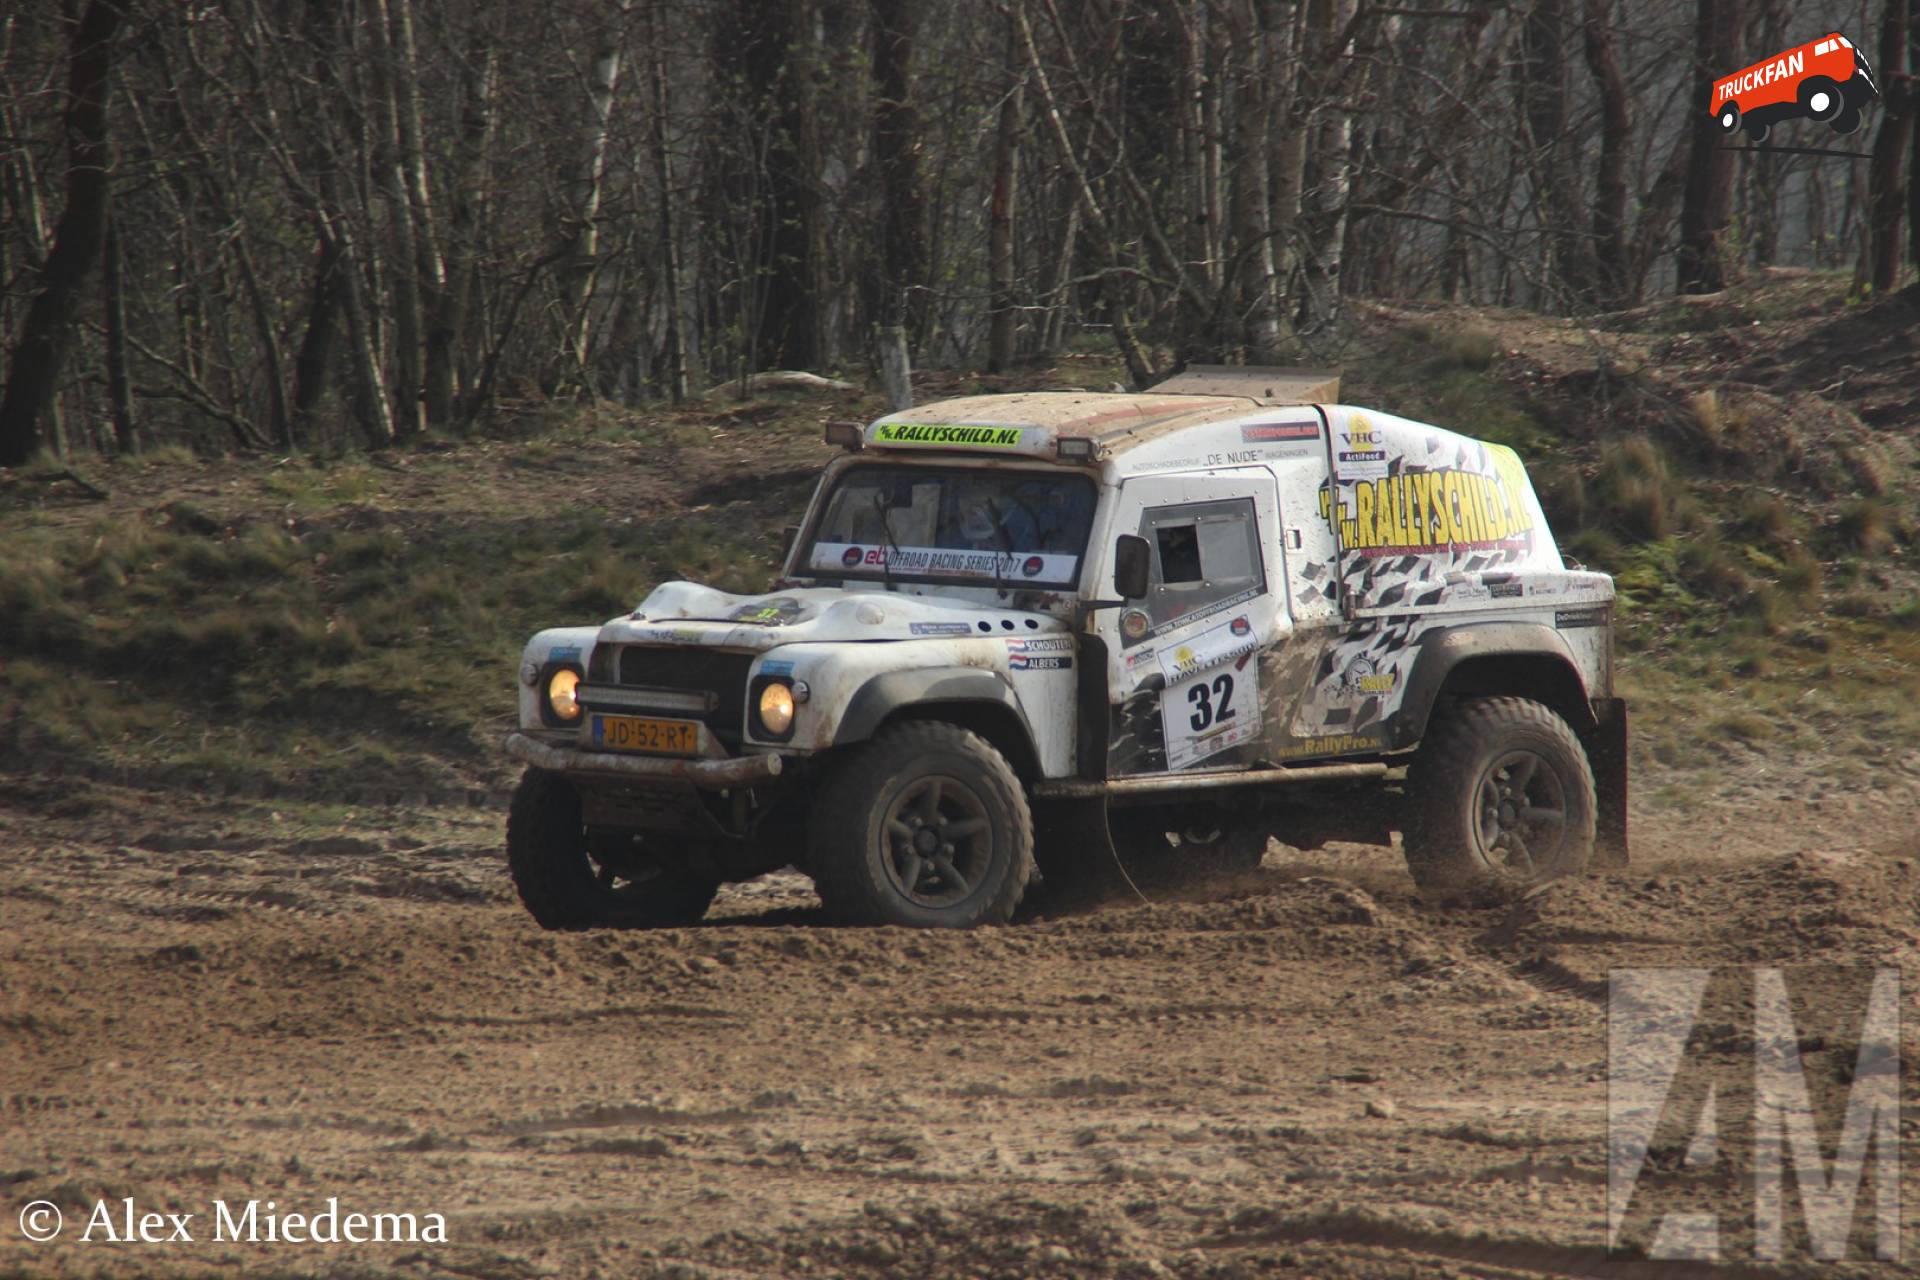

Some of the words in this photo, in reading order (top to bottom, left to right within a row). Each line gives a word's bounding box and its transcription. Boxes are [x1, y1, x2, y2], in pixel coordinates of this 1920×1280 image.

[1339, 430, 1382, 446] VHC
[888, 550, 929, 568] OFFROAD
[928, 552, 964, 570] RACING
[963, 553, 998, 571] SERIES
[1029, 657, 1060, 669] ALBERS
[1187, 673, 1236, 732] 32
